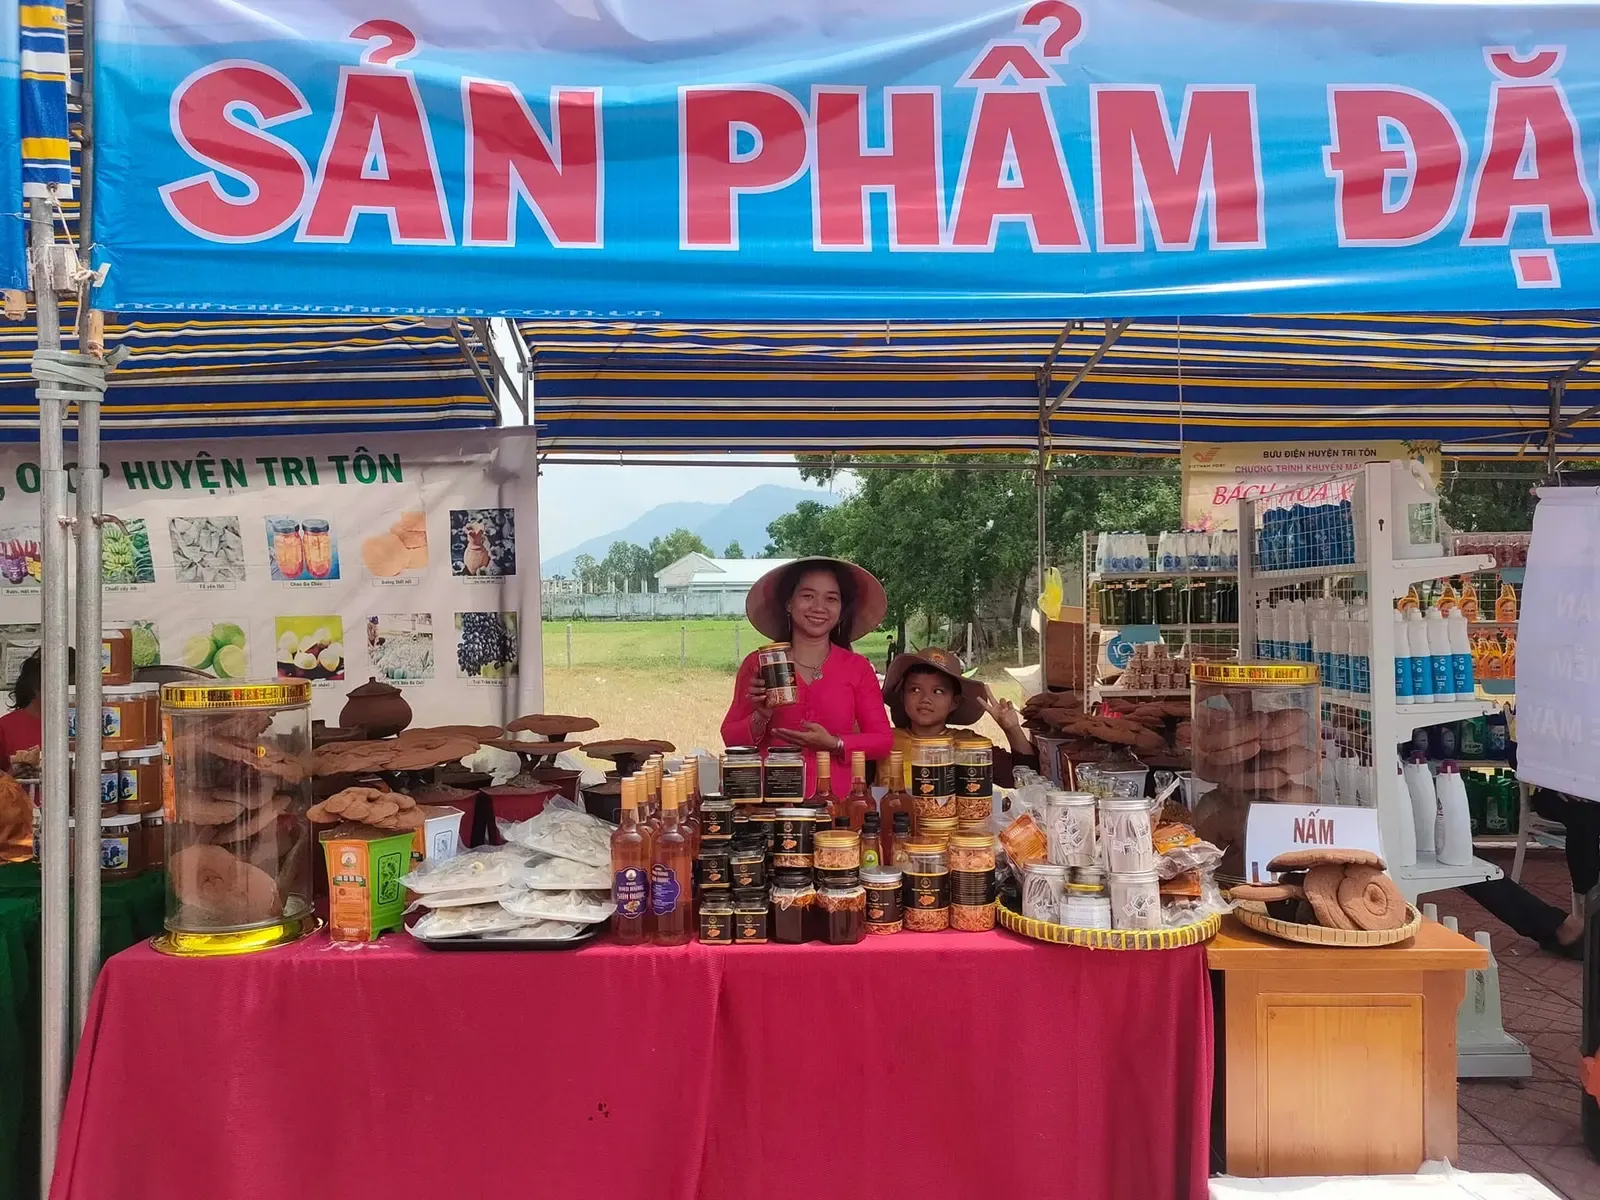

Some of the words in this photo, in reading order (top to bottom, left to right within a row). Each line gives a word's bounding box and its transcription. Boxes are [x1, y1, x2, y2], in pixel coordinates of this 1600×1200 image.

[159, 18, 604, 249] SẢN
[678, 0, 1266, 253] PHẨM
[1322, 44, 1600, 289] ĐẶ
[1235, 464, 1272, 474] CHƯƠNG
[1275, 462, 1303, 473] TRÌNH
[1305, 460, 1342, 472] KHUYẾN
[1263, 450, 1282, 459] BƯU
[1285, 448, 1306, 459] ĐIỆN
[1308, 447, 1339, 459] HUYỆN
[1341, 449, 1356, 457] TRI
[1358, 447, 1377, 457] TÔN
[121, 450, 249, 495] HUYỆN
[255, 456, 320, 486] TRI
[327, 446, 403, 485] TÔN
[1212, 480, 1277, 505] BÁCH
[1294, 809, 1334, 845] NẤM
